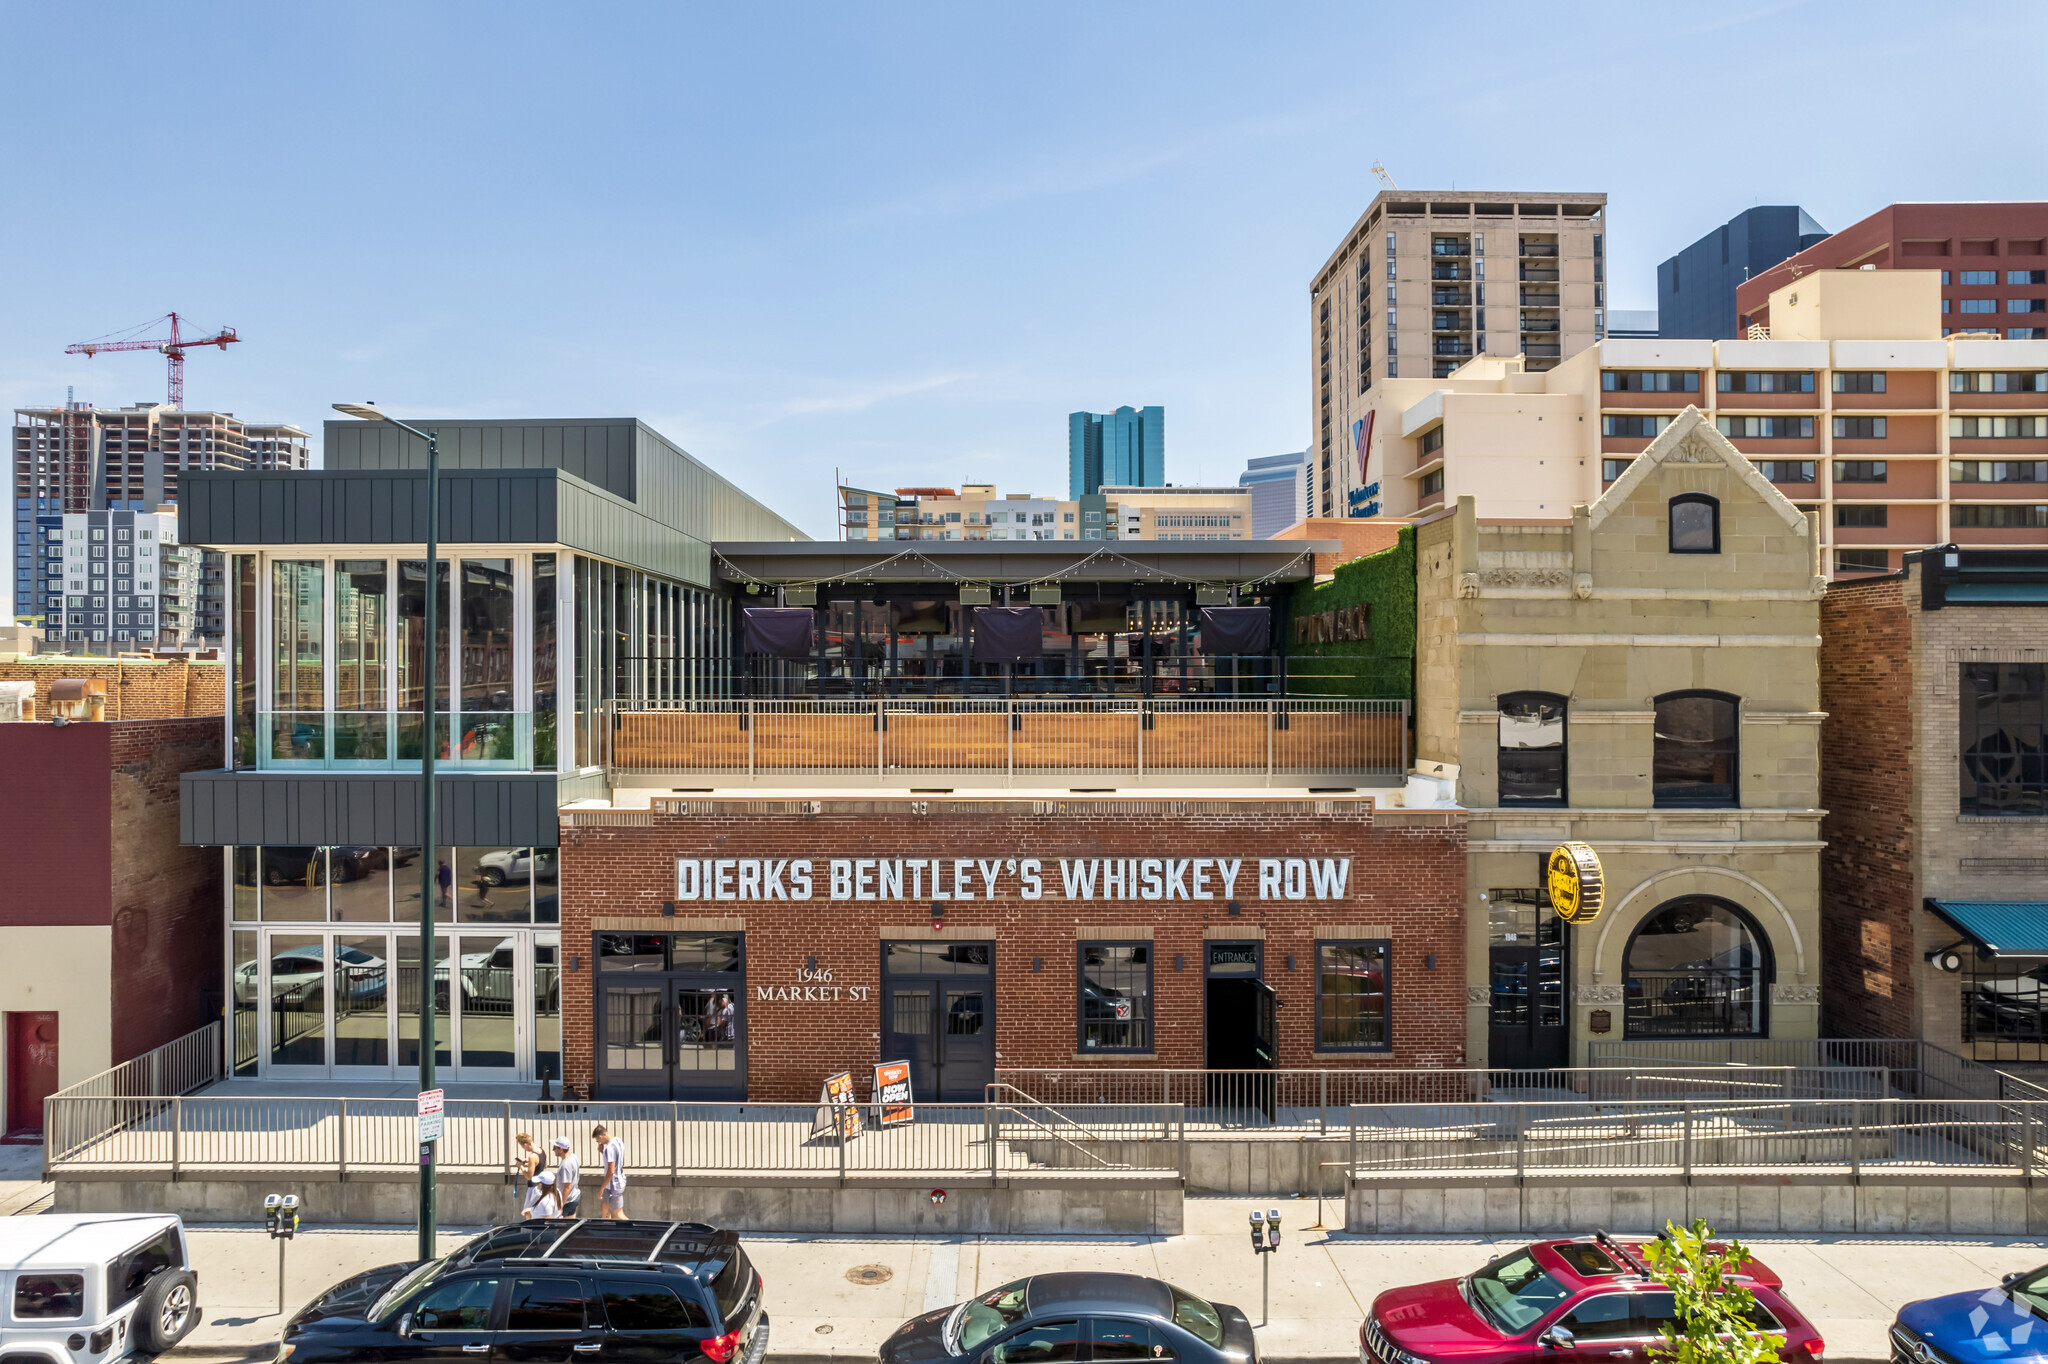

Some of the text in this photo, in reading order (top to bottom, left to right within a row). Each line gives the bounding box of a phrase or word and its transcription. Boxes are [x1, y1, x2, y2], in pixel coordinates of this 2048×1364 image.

[678, 859, 1350, 900] DIERKS BENTLEY'S WHISKEY ROW
[1213, 951, 1254, 963] ENTRANCE
[797, 968, 833, 982] 1946
[757, 986, 870, 1001] MARKET ST
[883, 1083, 907, 1096] NOW
[882, 1091, 908, 1103] OPEN
